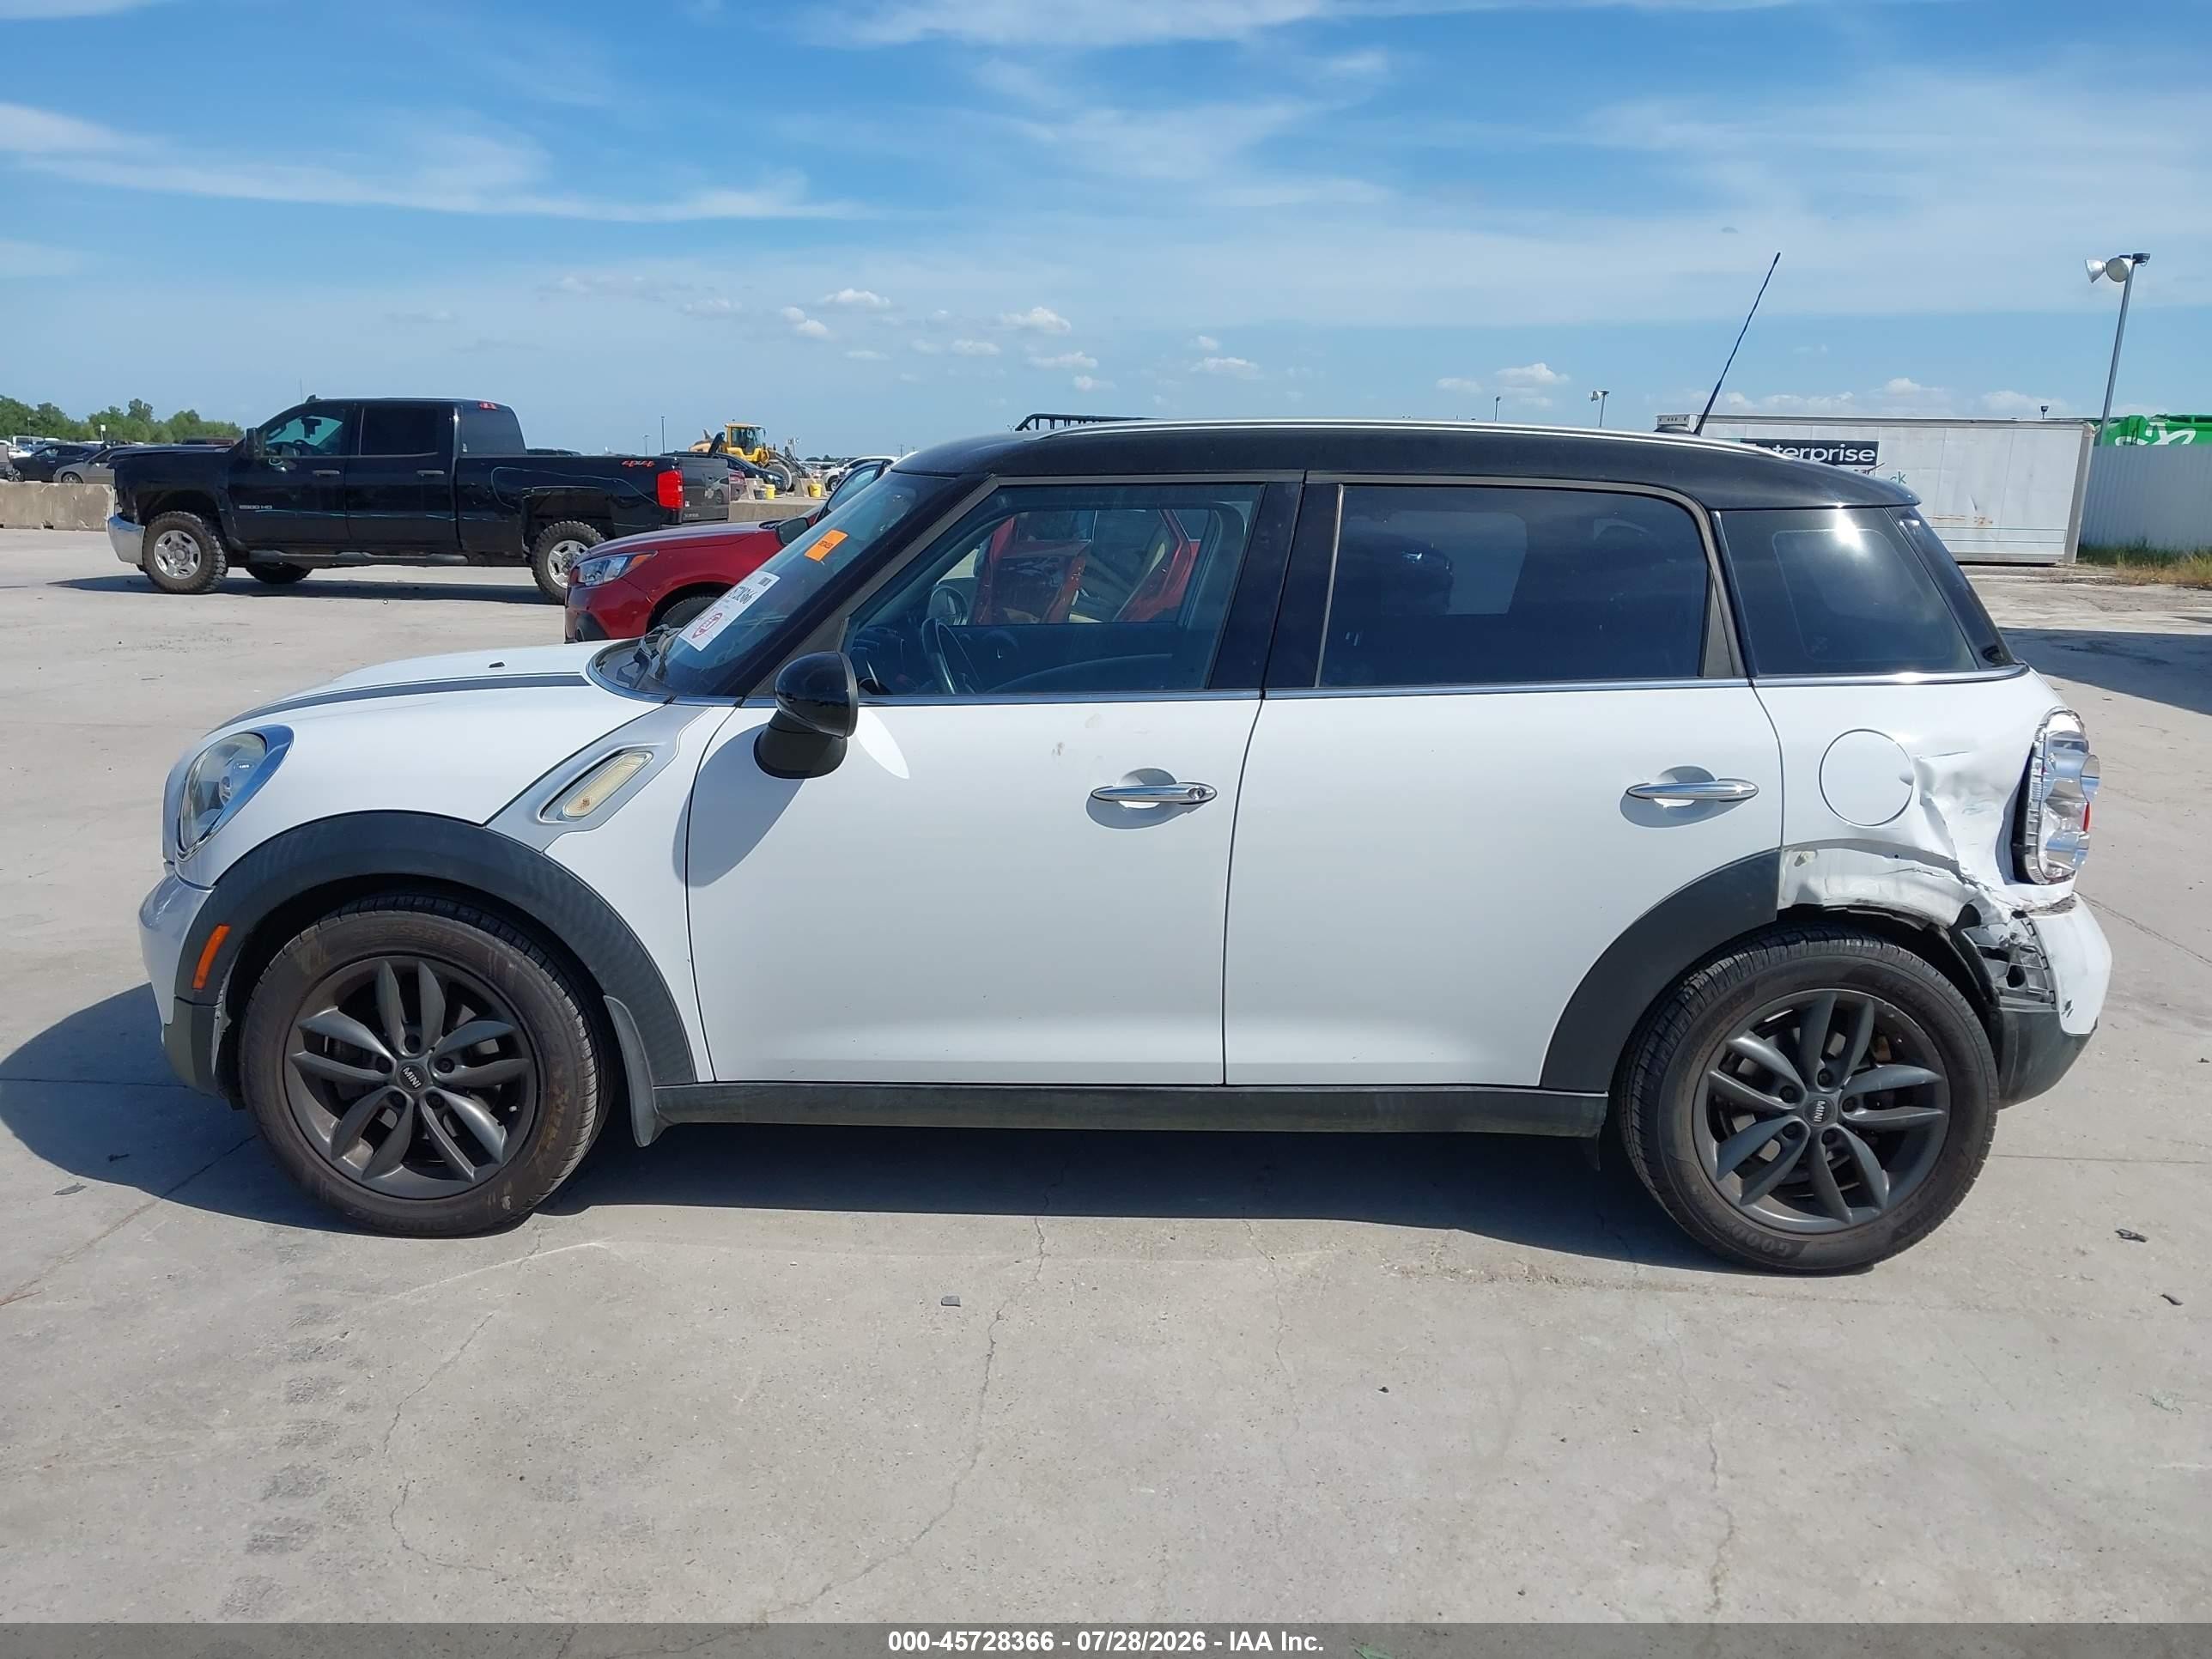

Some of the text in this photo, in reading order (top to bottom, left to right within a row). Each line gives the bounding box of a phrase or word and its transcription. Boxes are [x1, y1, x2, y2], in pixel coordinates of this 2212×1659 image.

[1746, 443, 1876, 462] terprise
[402, 1066, 422, 1088] MINI
[1813, 1100, 1826, 1122] MINI
